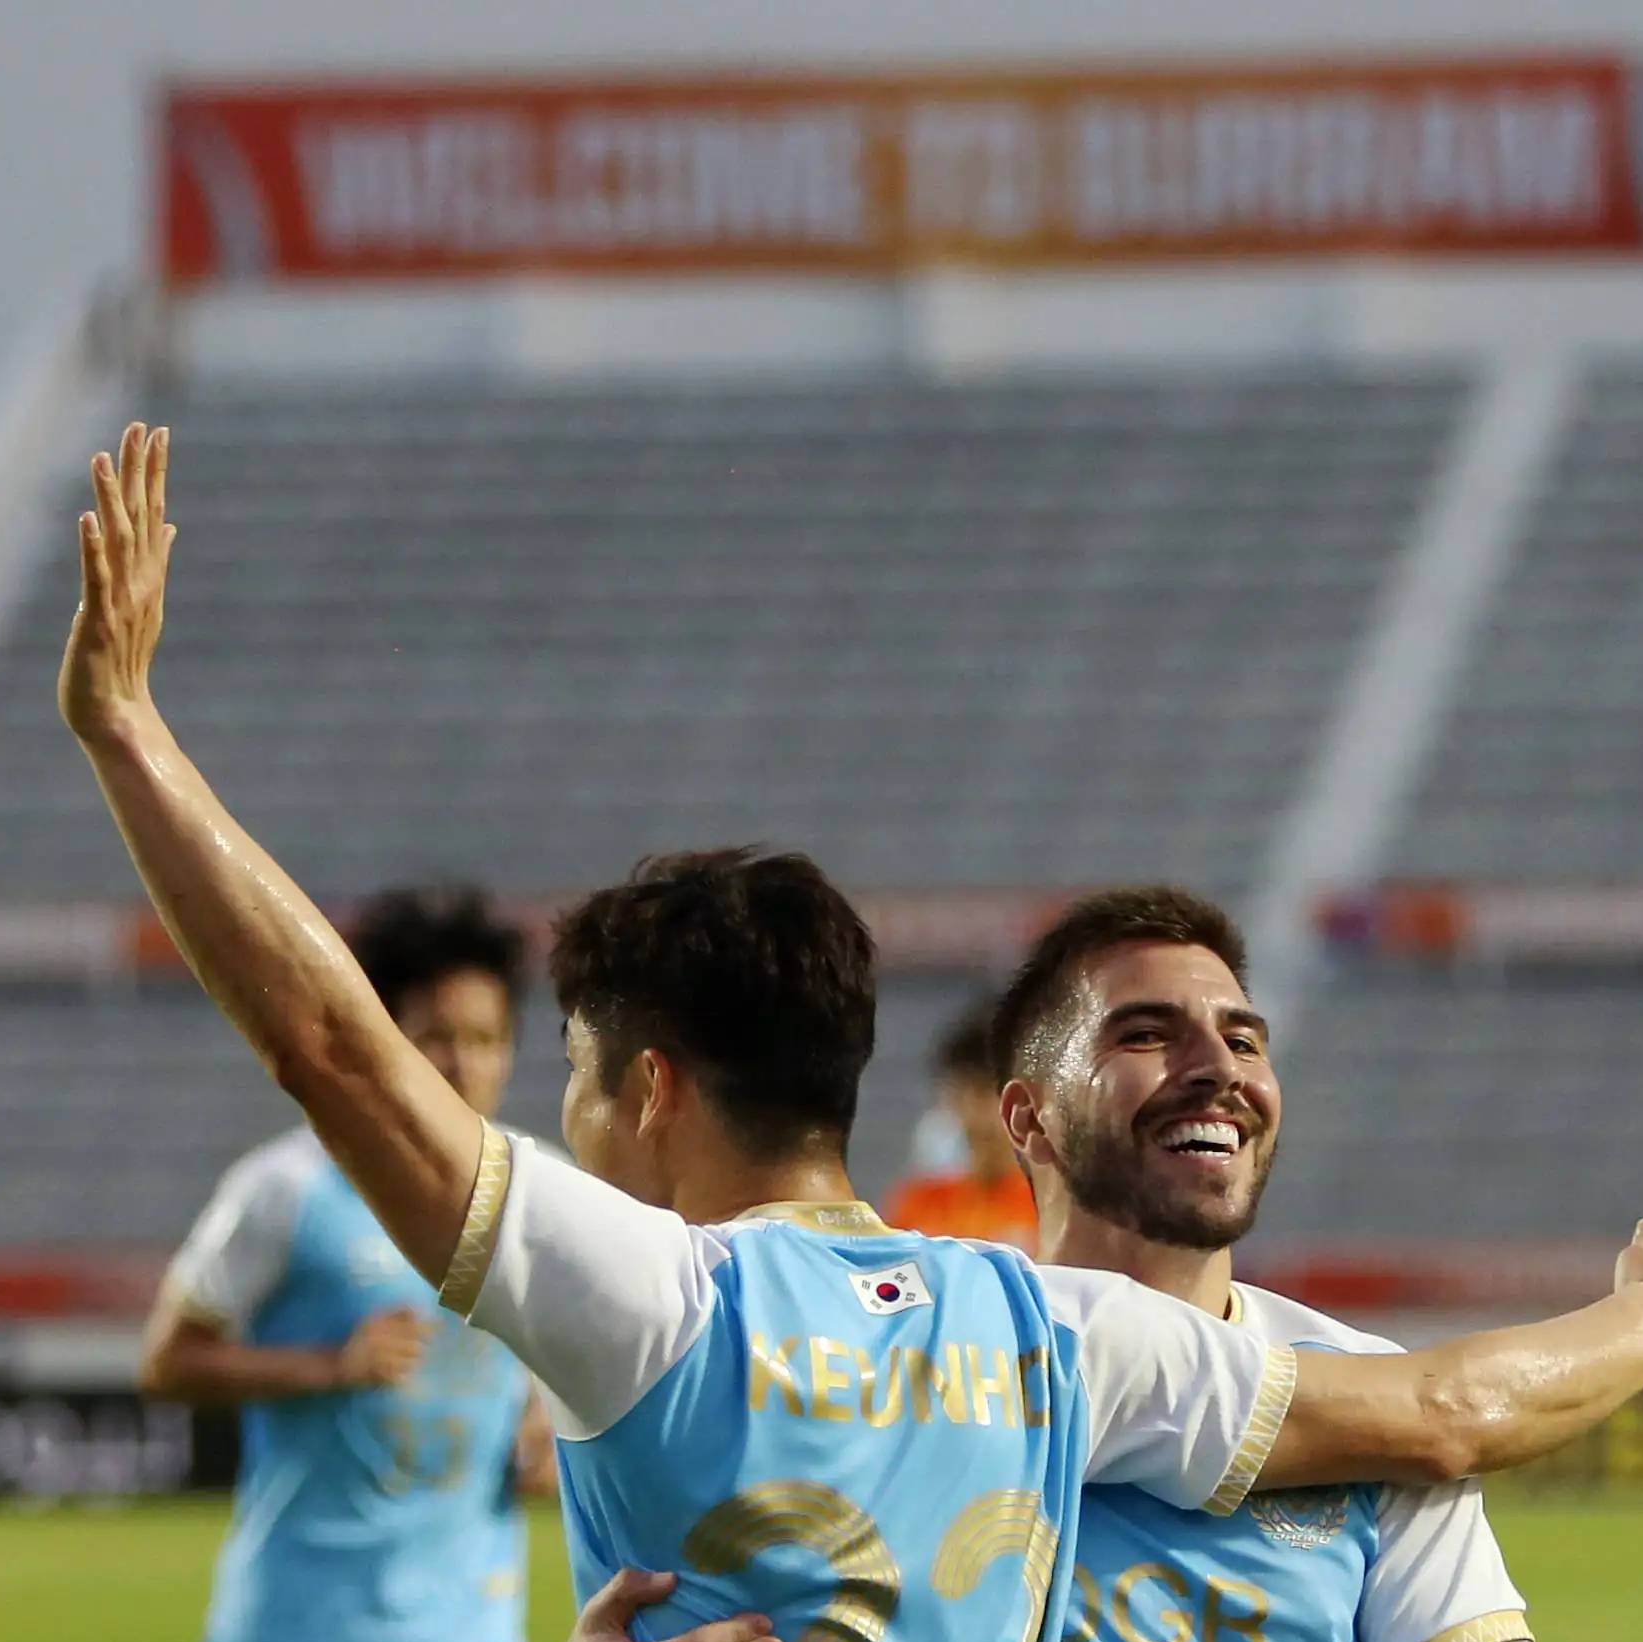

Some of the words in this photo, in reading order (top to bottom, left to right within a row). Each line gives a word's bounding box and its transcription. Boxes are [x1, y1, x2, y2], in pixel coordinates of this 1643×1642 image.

[296, 104, 866, 252] WELCOME
[908, 97, 1036, 242] TO
[748, 1331, 1050, 1429] KEUNHO
